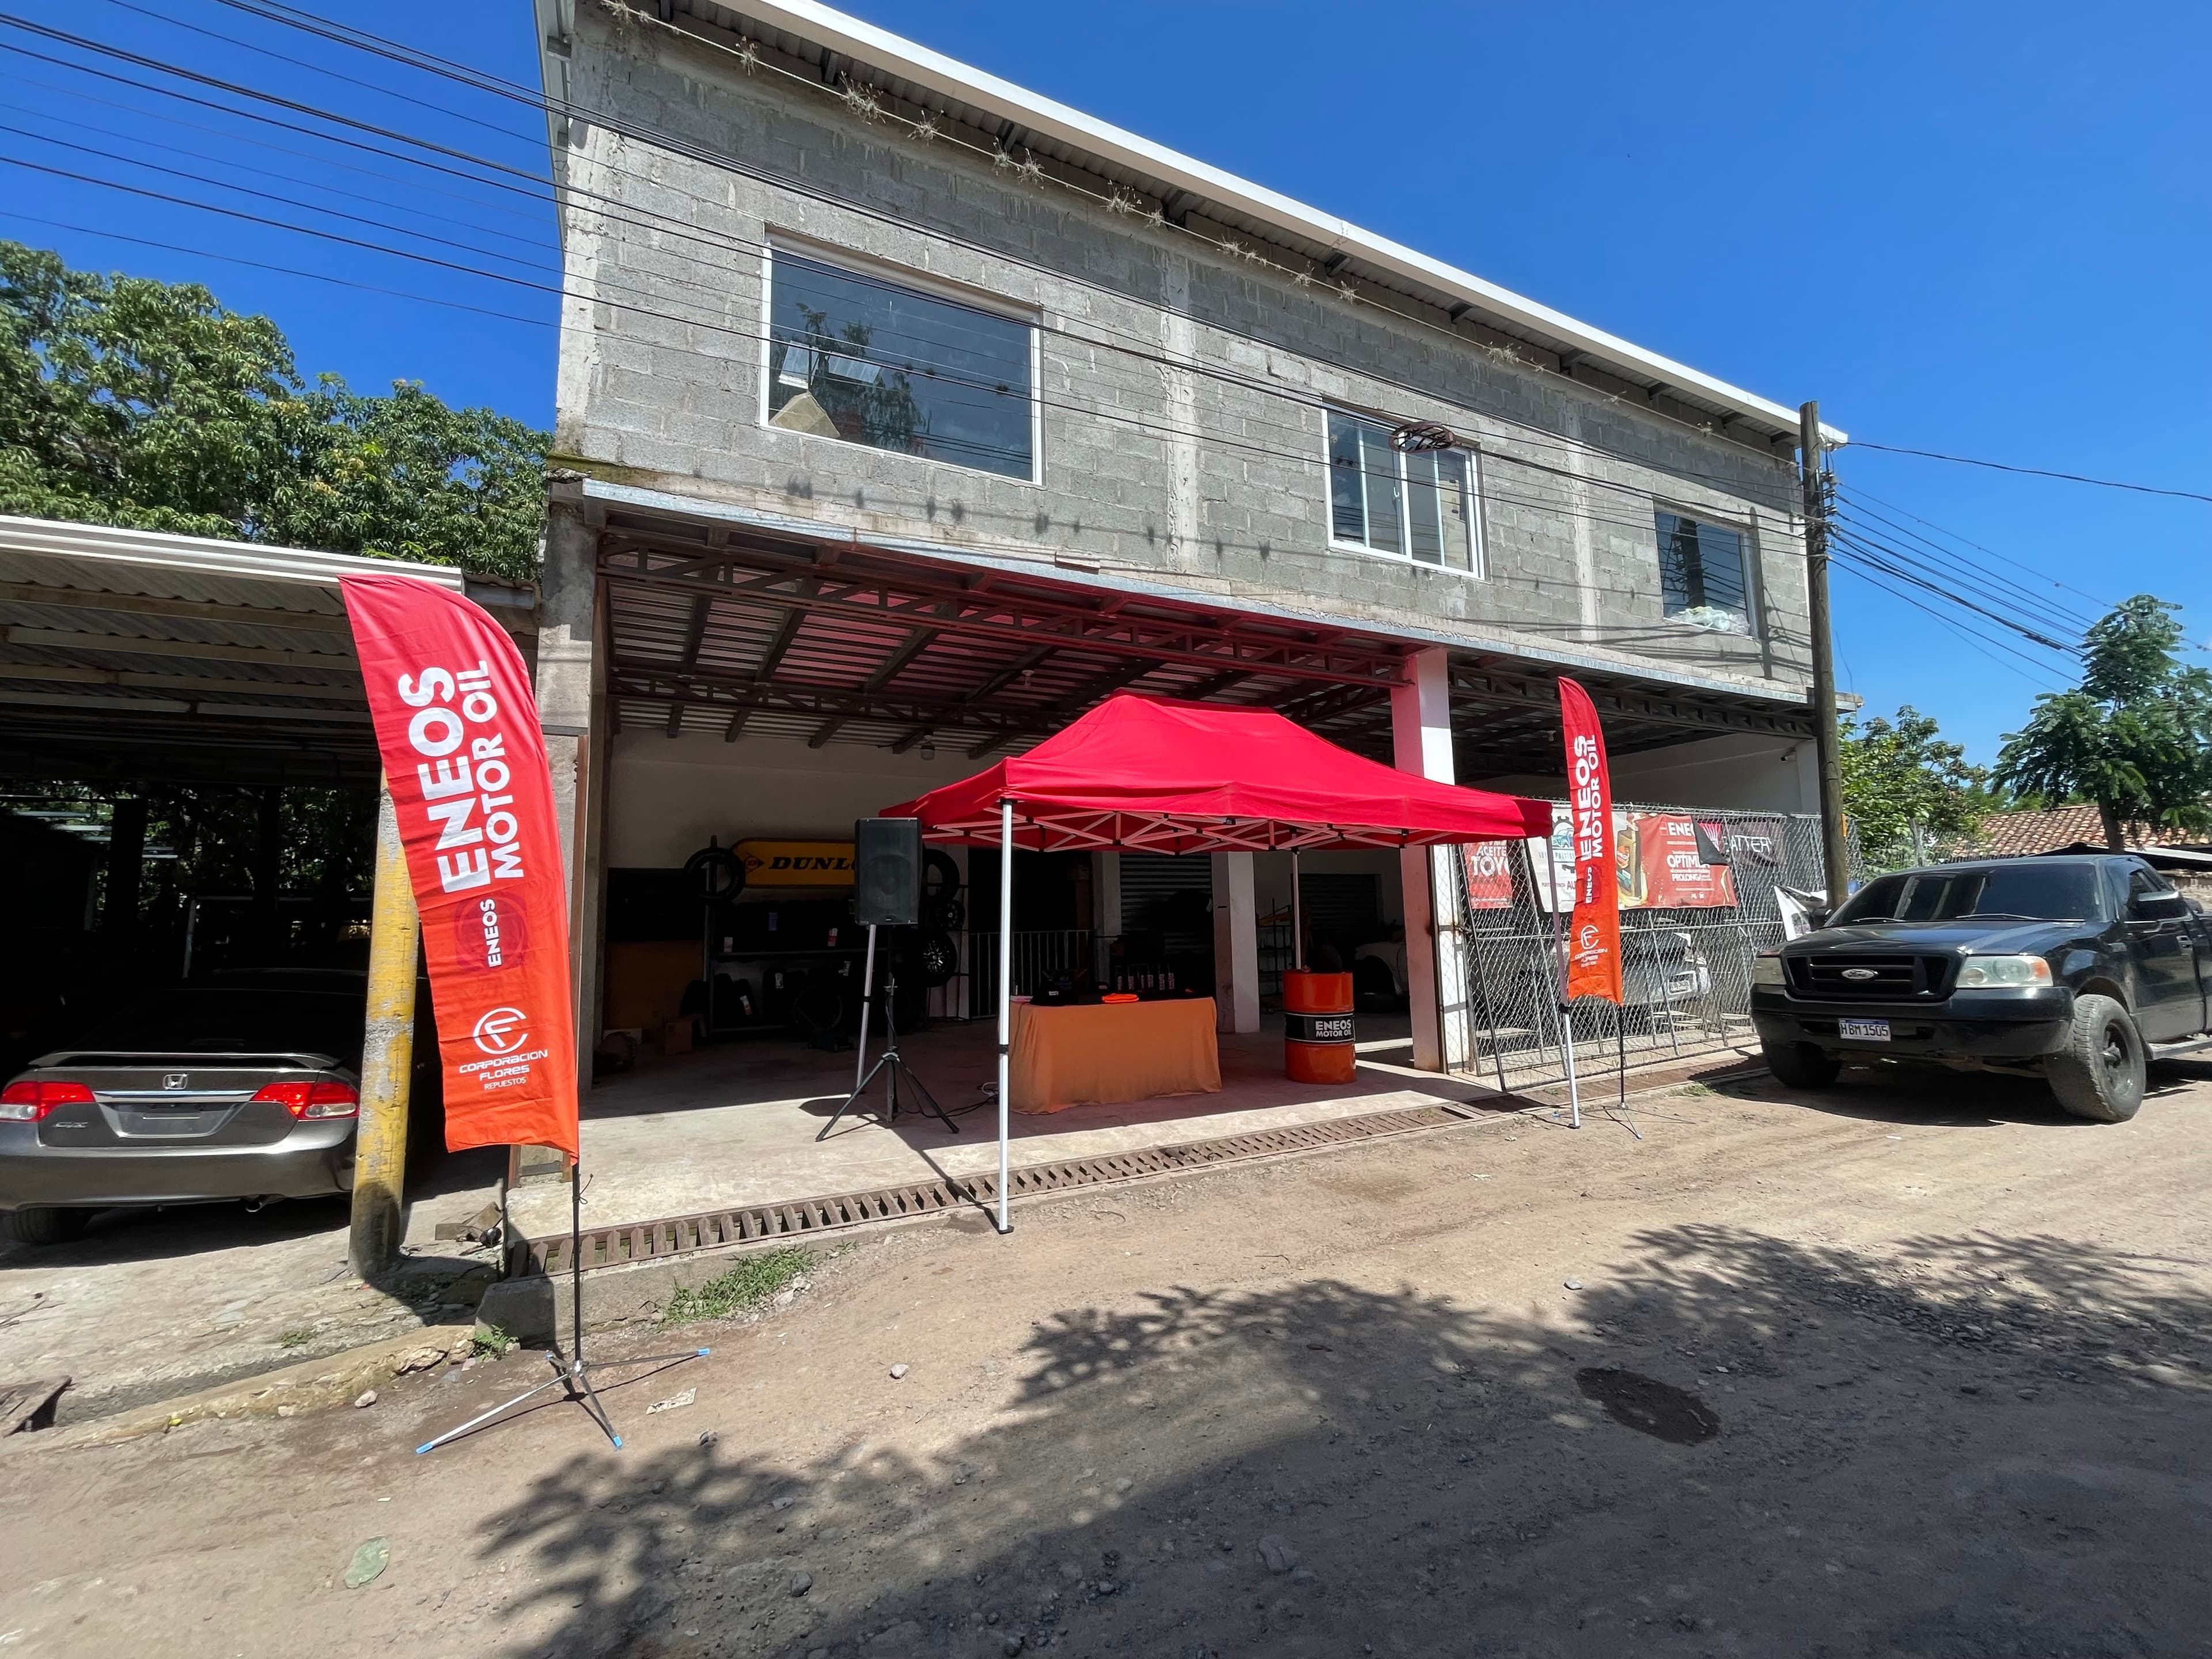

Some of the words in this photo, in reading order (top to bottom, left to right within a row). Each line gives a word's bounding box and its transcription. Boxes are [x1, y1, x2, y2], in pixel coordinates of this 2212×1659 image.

[456, 660, 497, 724] OIL
[1586, 734, 1599, 770] OIL
[398, 667, 491, 893] ENEOS
[471, 733, 524, 878] MOTOR
[1574, 735, 1592, 861] ENEOS
[1590, 777, 1603, 858] MOTOR
[1476, 846, 1507, 856] ACEITE
[1723, 835, 1772, 853] ATTER
[768, 857, 855, 870] DUNL
[480, 899, 502, 967] ENEOS
[1315, 1019, 1351, 1030] ENEOS
[459, 1049, 548, 1074] CORPORACION
[479, 1065, 530, 1081] FLORES
[484, 1077, 527, 1090] REPUESTOS
